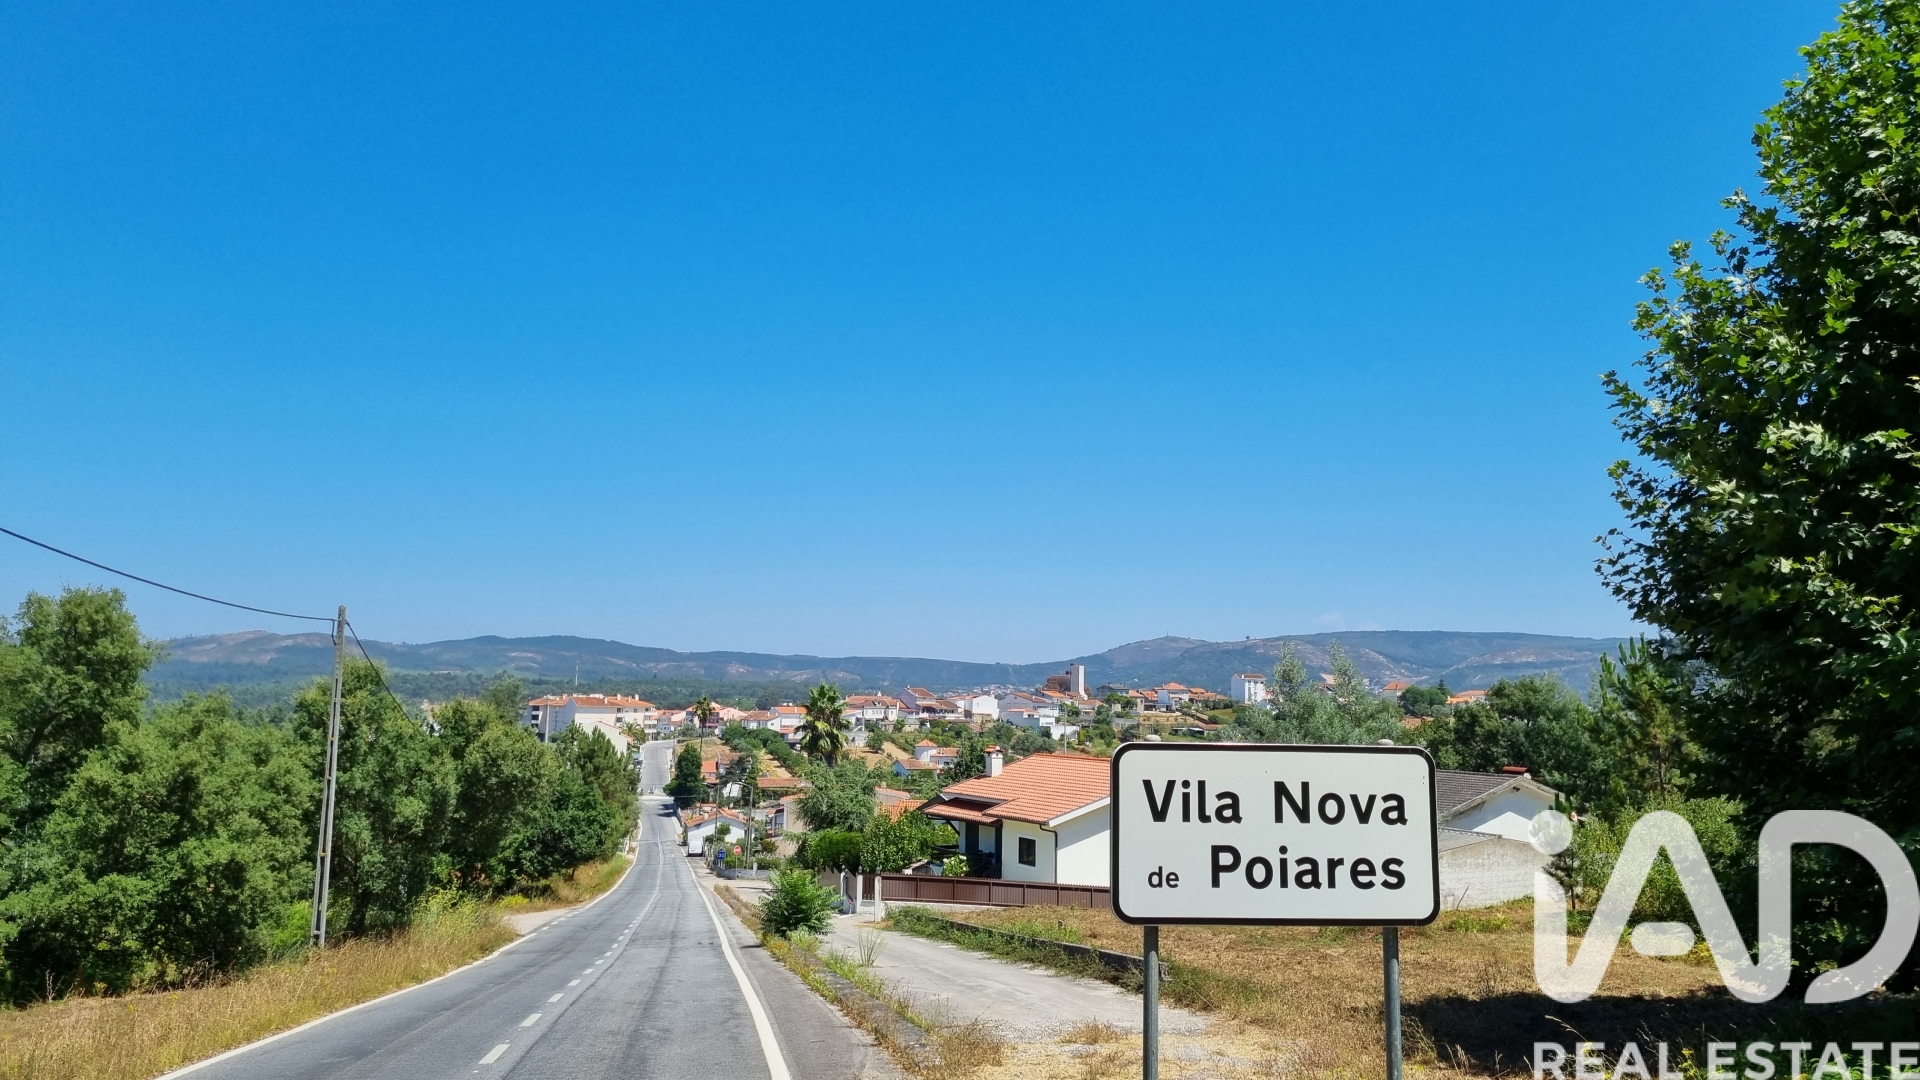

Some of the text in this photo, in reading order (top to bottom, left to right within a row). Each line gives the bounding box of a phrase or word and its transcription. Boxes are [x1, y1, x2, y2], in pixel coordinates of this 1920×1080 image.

[1142, 779, 1408, 826] Vila Nova
[1147, 844, 1406, 890] de Poiares
